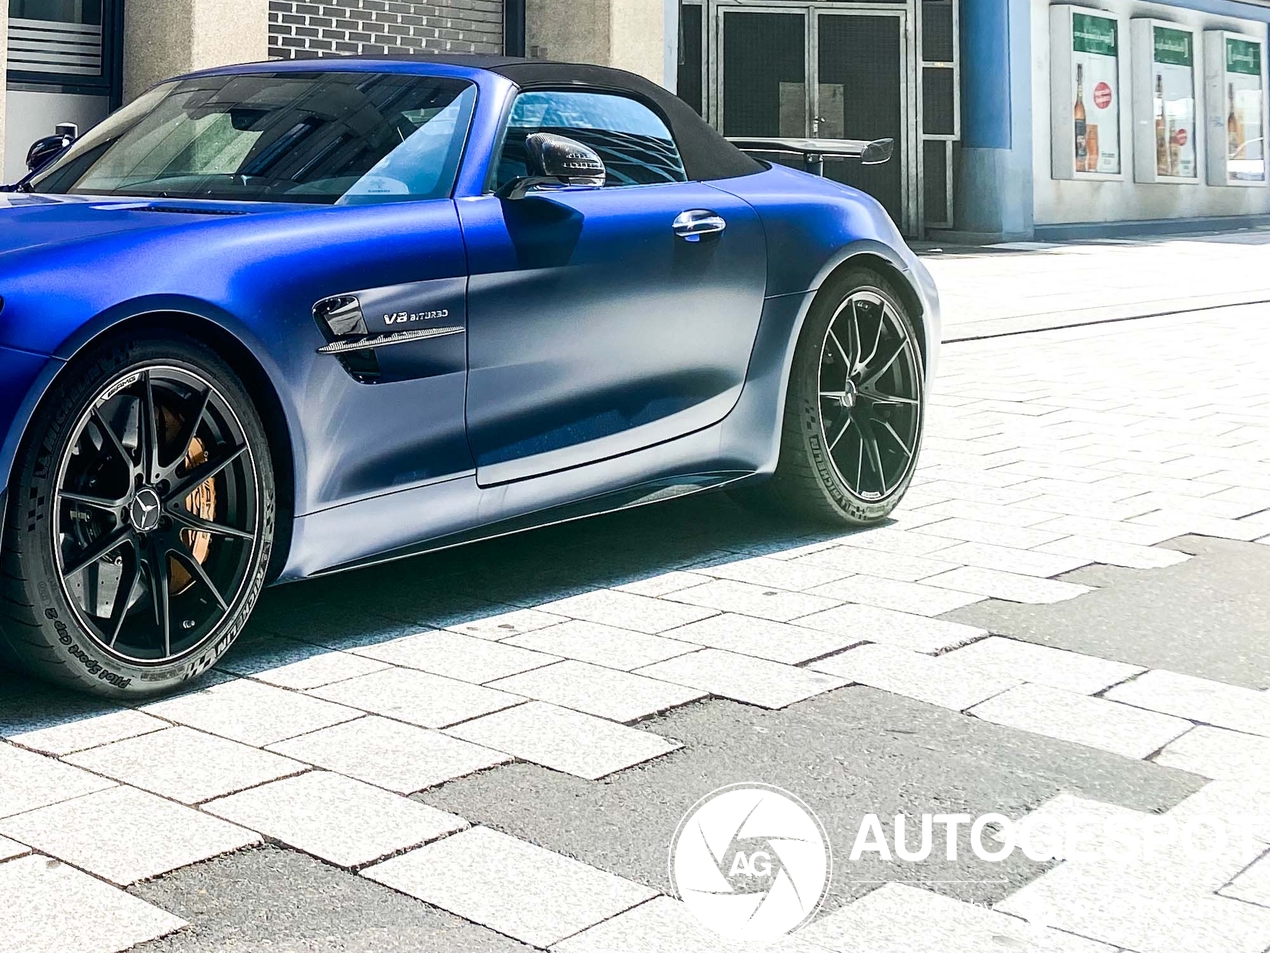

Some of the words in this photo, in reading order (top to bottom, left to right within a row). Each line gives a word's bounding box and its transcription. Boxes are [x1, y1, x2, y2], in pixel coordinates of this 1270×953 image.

[383, 312, 408, 325] V8
[409, 309, 449, 322] BITURBO
[216, 567, 265, 655] MICHELIN
[68, 644, 101, 676] Sport
